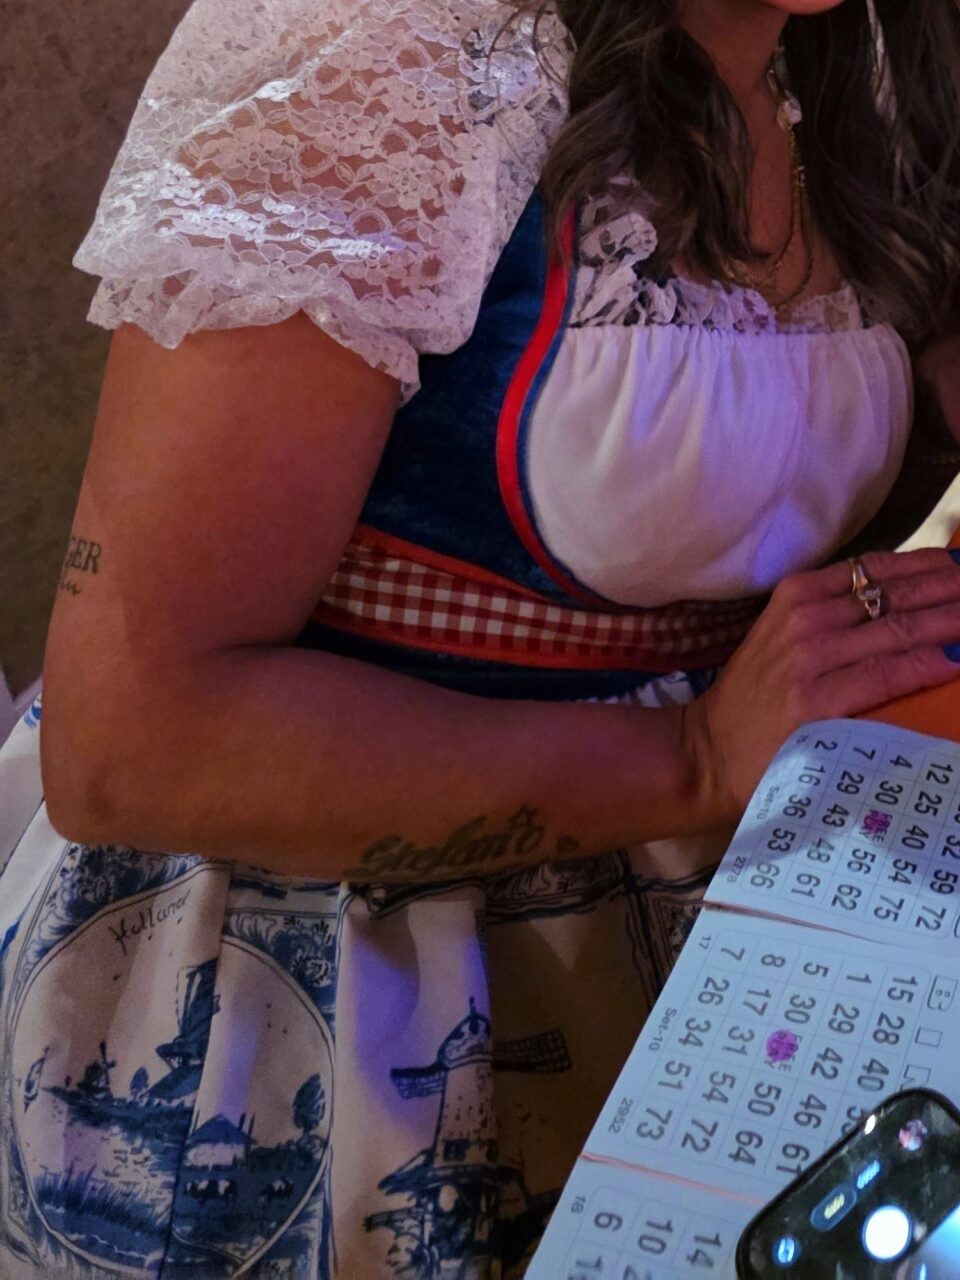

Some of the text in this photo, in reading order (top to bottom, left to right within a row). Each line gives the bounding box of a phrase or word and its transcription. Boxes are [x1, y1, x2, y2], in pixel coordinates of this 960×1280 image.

[749, 739, 839, 890] 2 16 36 53 66
[790, 746, 877, 899] 7 29 43 48 61
[830, 754, 914, 911] 4 30 56 62
[873, 762, 955, 923] 12 25 40 54 75
[928, 868, 960, 895] 59
[109, 888, 192, 957] Holland
[914, 904, 948, 932] 72
[635, 947, 746, 1141] 7 26 34 51 73
[648, 1008, 678, 1052] Set-10
[680, 953, 787, 1154] 8 17 31 54 72
[727, 961, 830, 1167] 5 30 50 64
[793, 973, 873, 1130] 1 29 42 46
[856, 975, 919, 1092] 15 28 40
[608, 1097, 634, 1134] 2952
[593, 1211, 624, 1232] 6
[637, 1219, 674, 1255] 10
